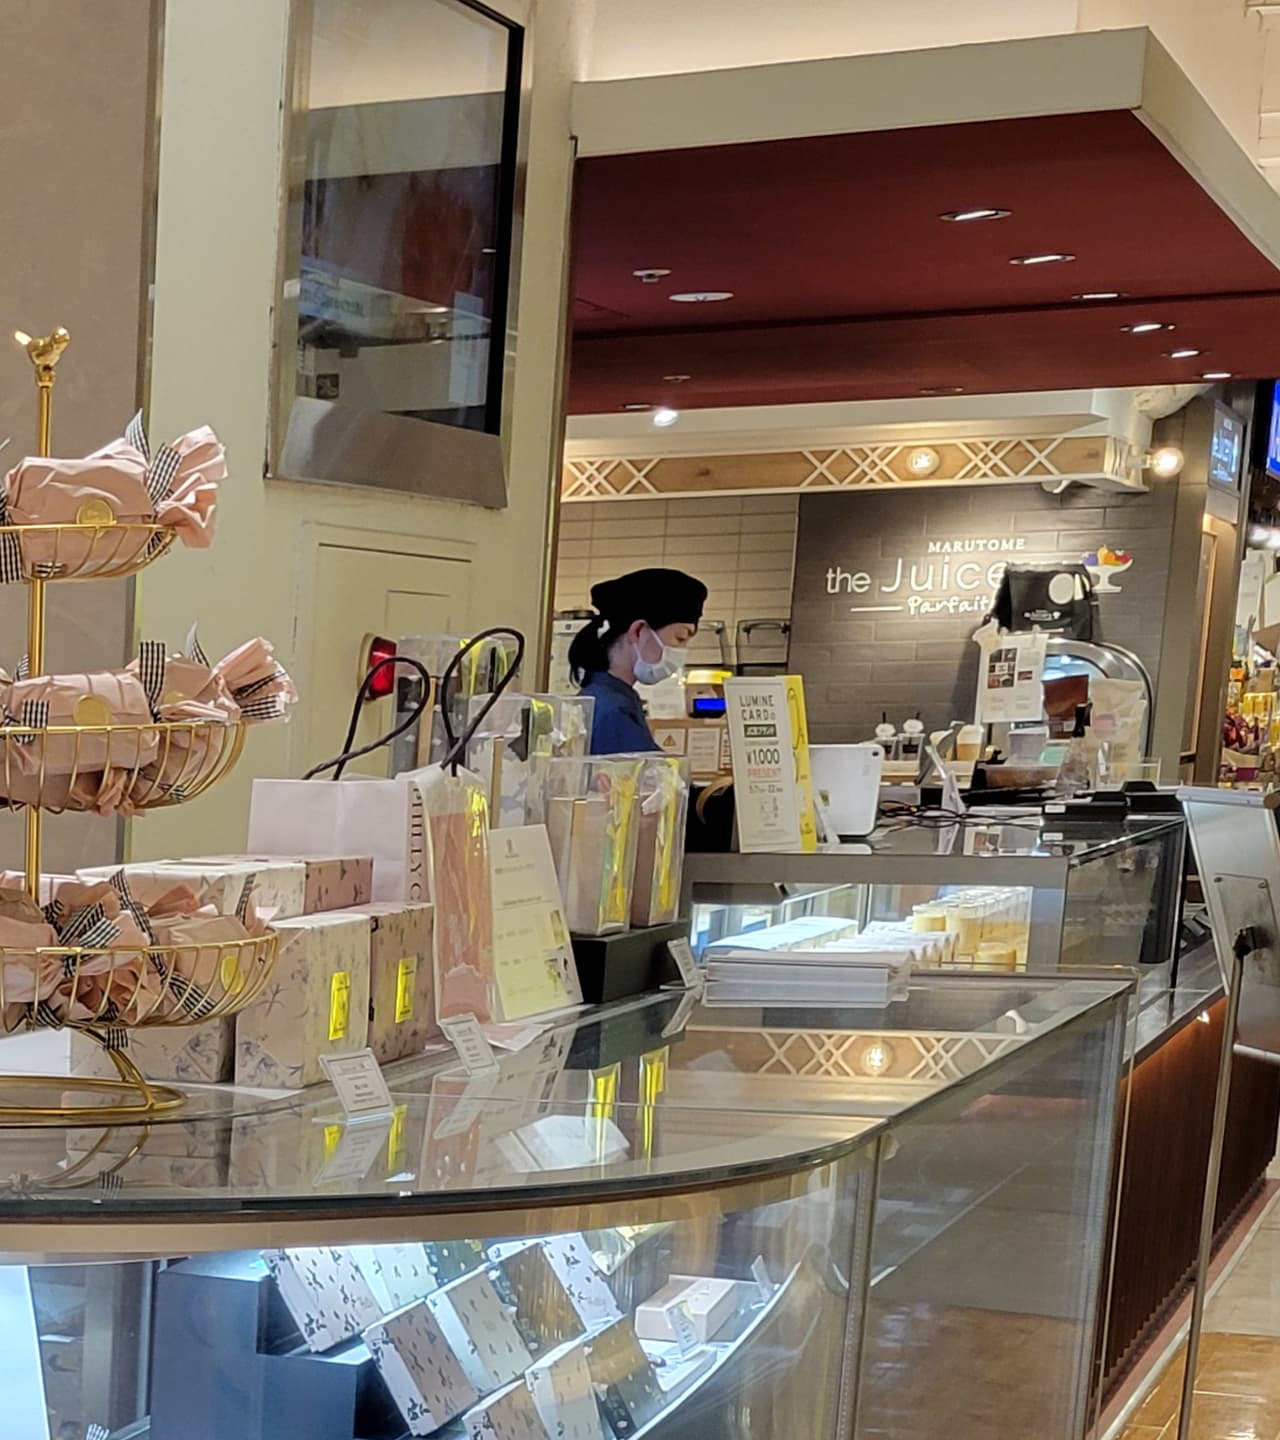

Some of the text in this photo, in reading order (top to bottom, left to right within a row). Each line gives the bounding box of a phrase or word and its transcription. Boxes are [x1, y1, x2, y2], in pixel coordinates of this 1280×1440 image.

[927, 538, 1026, 554] MARUTOME
[825, 567, 872, 594] the
[739, 694, 775, 707] LUMINE
